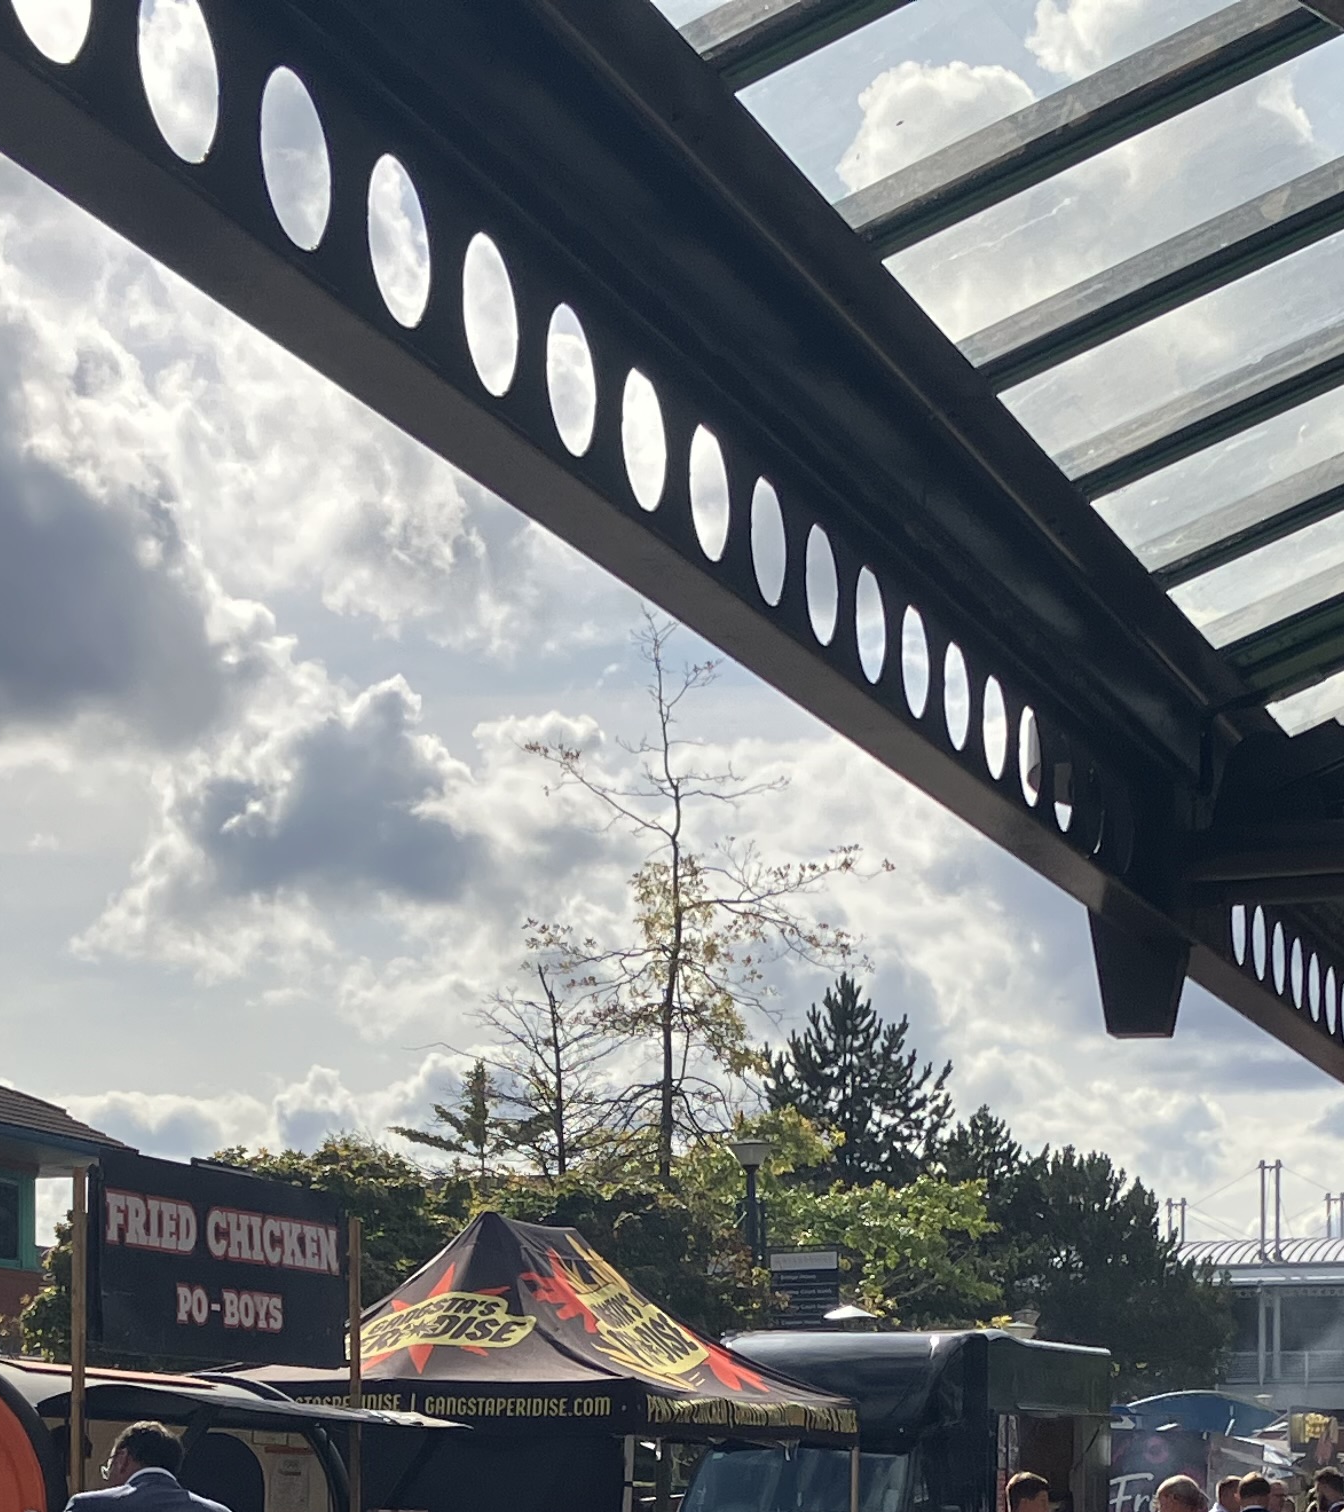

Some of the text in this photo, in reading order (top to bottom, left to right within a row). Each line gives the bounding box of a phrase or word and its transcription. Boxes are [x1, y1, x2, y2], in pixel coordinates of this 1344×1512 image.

[105, 1188, 340, 1275] FRIED CHICKEN
[176, 1282, 284, 1333] PO-BOYS
[368, 1297, 501, 1336] GANGSTA'S
[425, 1394, 611, 1417] GANGSTAPERIDISE.COM
